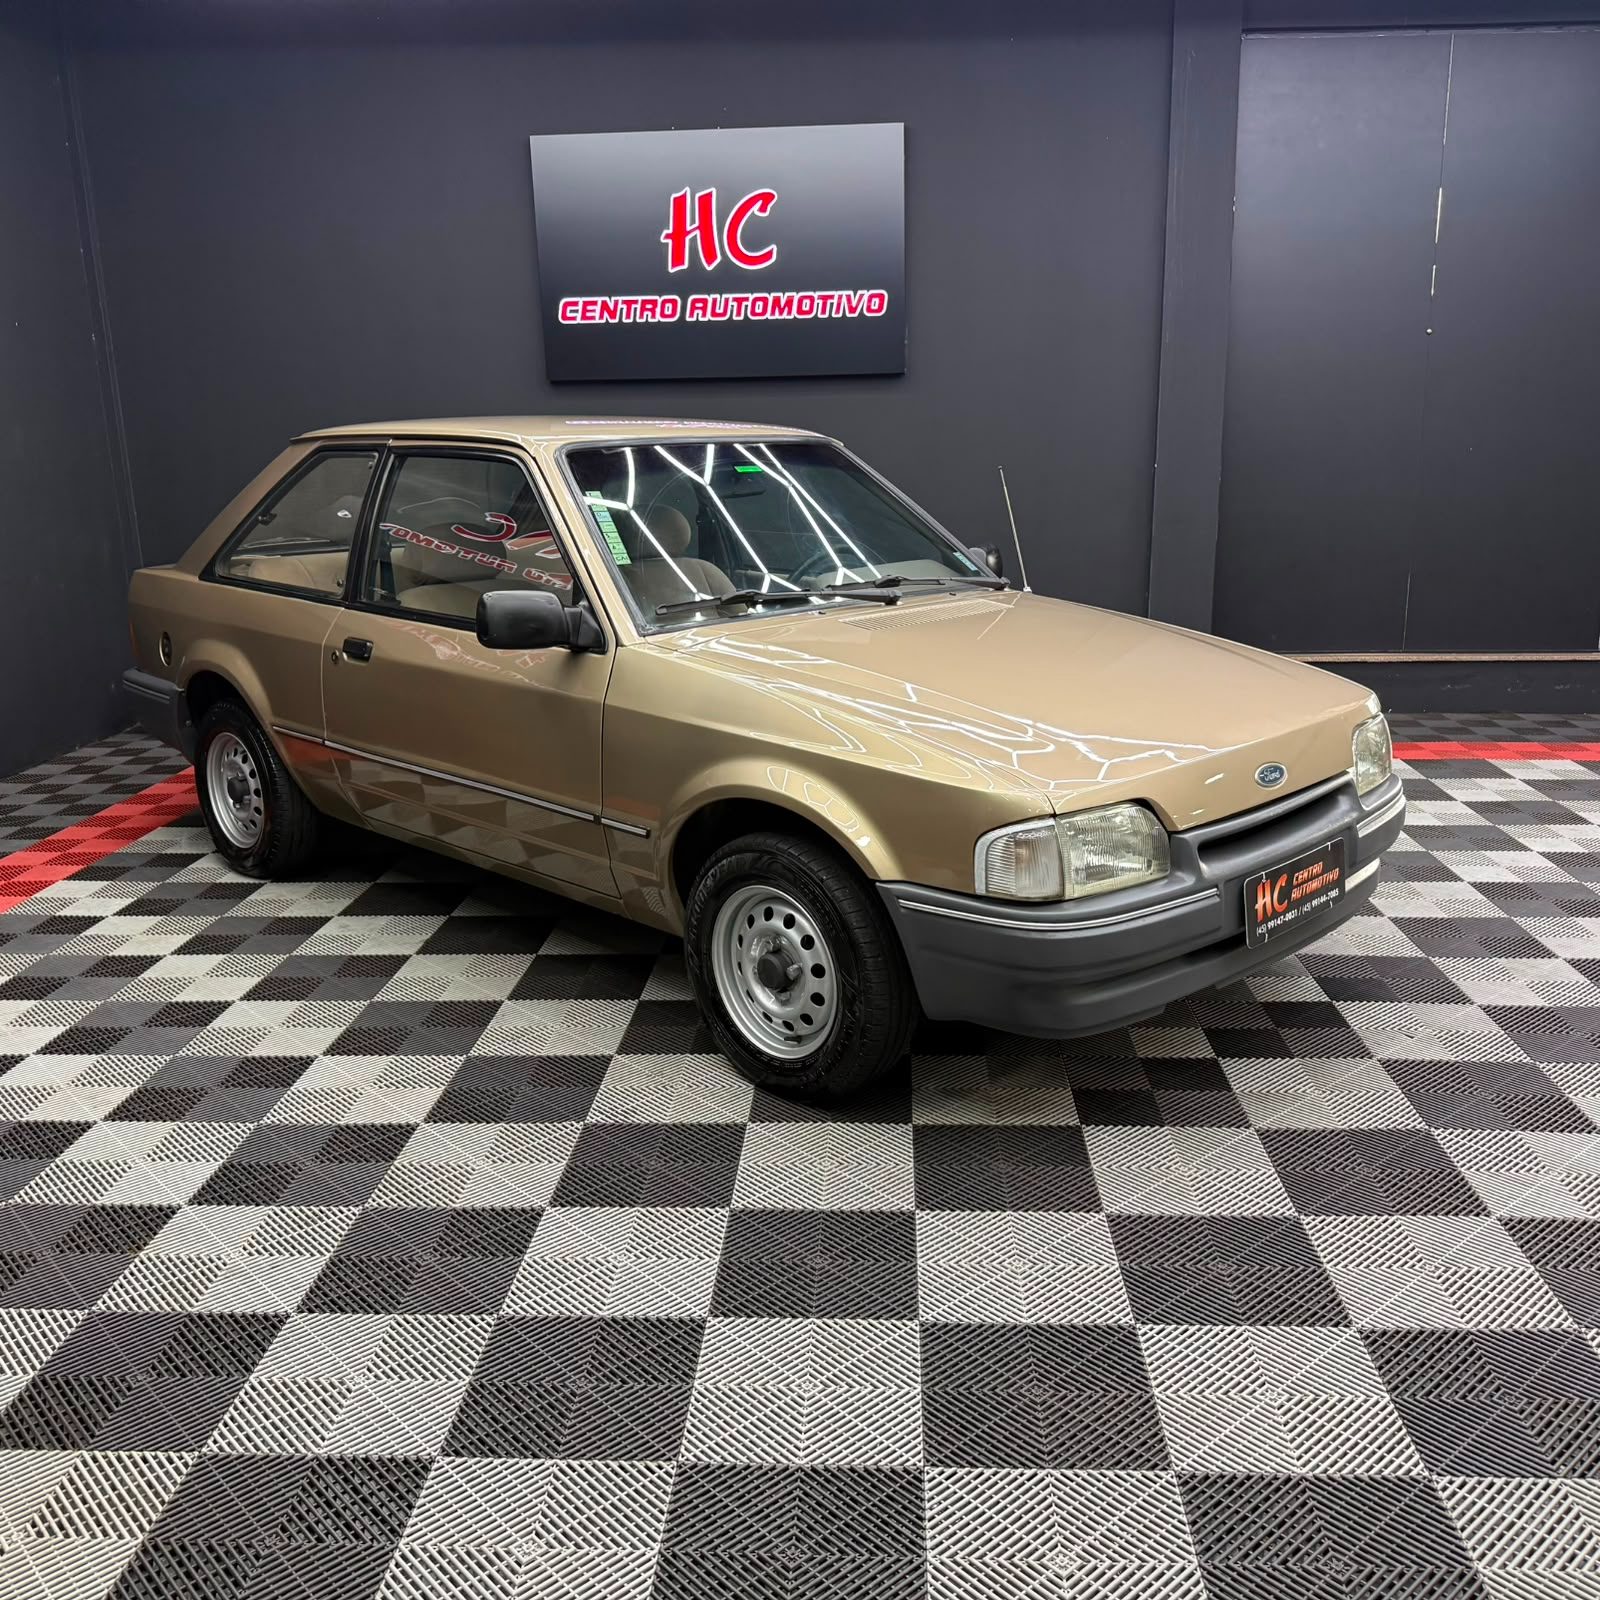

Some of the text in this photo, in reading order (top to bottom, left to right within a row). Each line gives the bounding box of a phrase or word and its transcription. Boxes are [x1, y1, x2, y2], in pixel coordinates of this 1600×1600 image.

[661, 187, 777, 272] HC
[558, 289, 888, 324] CENTRO AUTOMOTIVO
[1259, 767, 1281, 781] Ford
[1291, 868, 1339, 902] AUTOMOTIVO
[1292, 861, 1323, 885] CENTRO
[1255, 874, 1288, 922] HC
